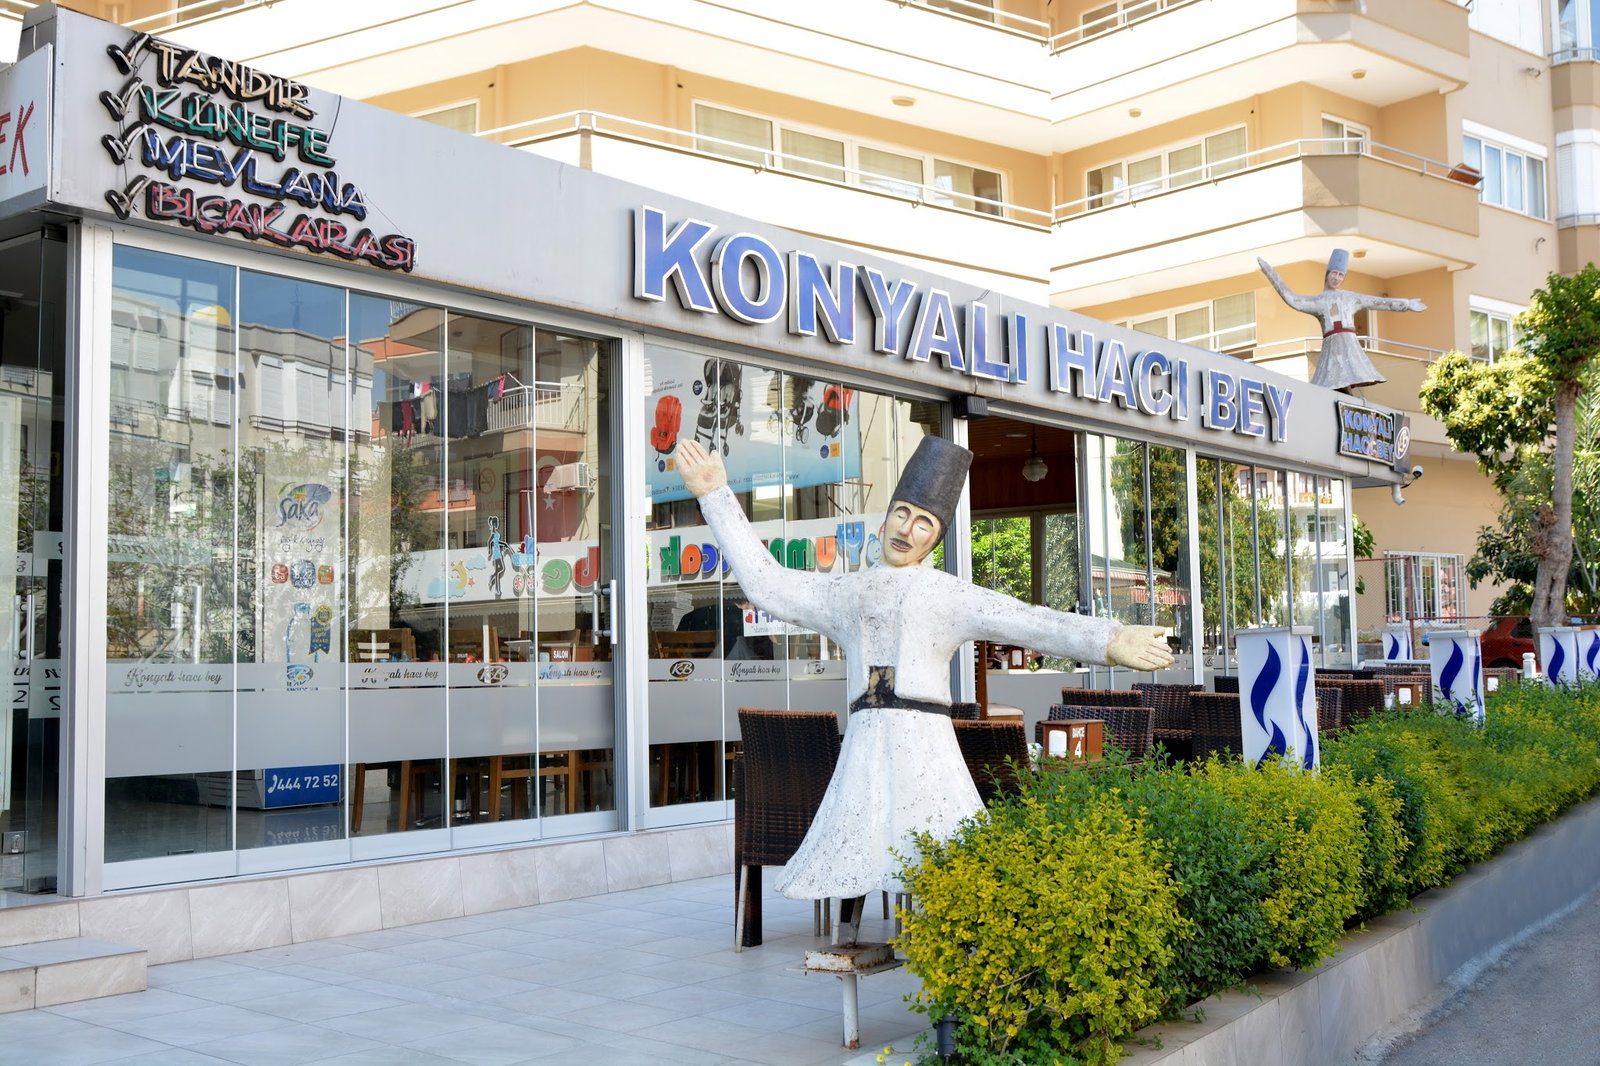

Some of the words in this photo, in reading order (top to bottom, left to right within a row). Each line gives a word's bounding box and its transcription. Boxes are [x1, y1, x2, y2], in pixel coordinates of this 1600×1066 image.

[150, 40, 316, 121] TANDIR
[142, 124, 368, 221] MEVLANA
[634, 204, 1028, 385] KONYALI
[1048, 321, 1189, 422] HACI
[1203, 367, 1294, 443] BEY
[1343, 409, 1392, 440] KONYALI
[1376, 440, 1394, 462] BEY
[276, 497, 319, 528] Saka
[553, 650, 569, 659] SALON
[670, 662, 694, 677] KB
[1074, 740, 1082, 759] 4
[277, 777, 301, 791] 444
[304, 776, 320, 789] 72
[323, 774, 338, 788] 52
